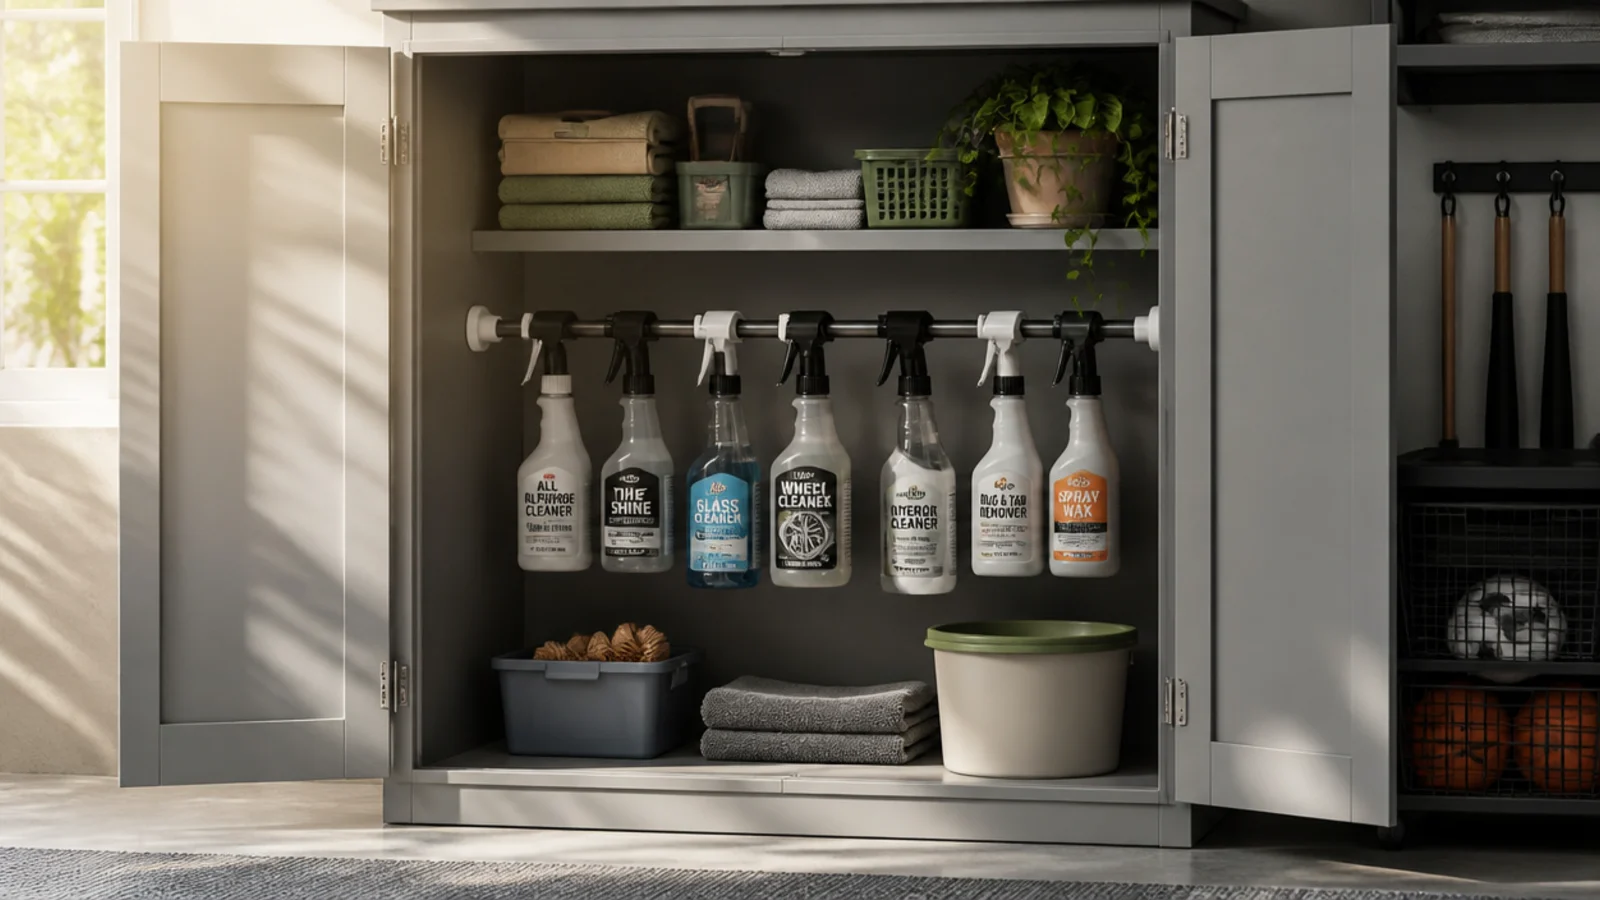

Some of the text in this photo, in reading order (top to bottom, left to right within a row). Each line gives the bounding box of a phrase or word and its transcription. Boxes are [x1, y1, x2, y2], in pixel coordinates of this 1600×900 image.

[537, 481, 558, 491] ALL
[1058, 490, 1100, 503] SPRAY
[525, 505, 572, 517] CLEANER
[611, 501, 651, 515] SHINE
[696, 499, 739, 513] GLASS
[1063, 504, 1092, 518] WAX
